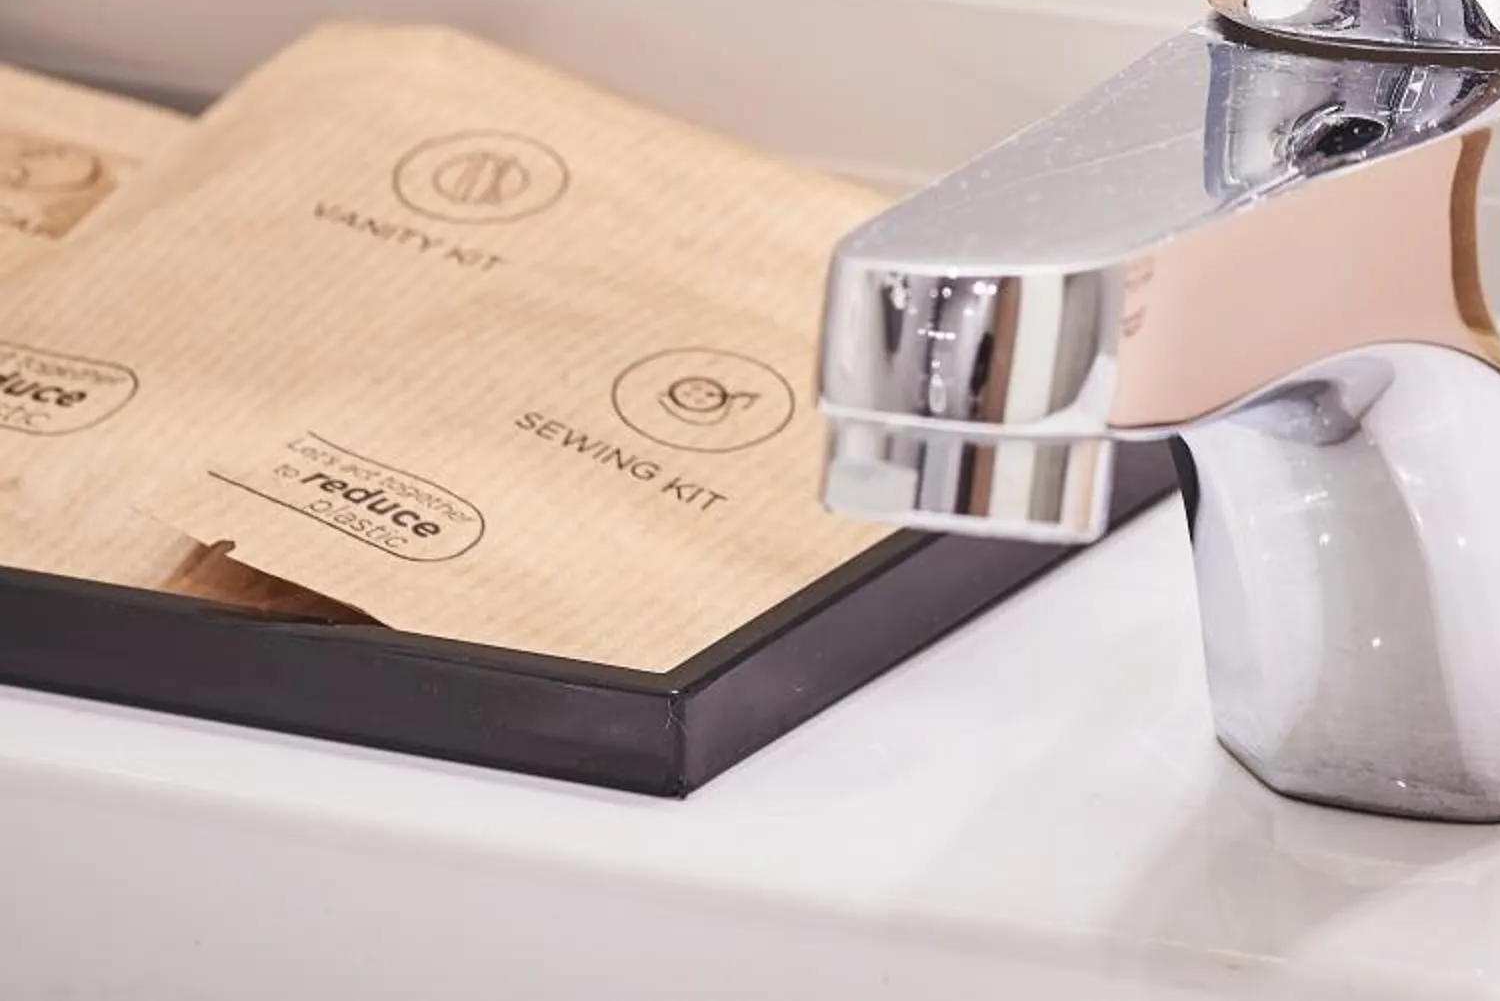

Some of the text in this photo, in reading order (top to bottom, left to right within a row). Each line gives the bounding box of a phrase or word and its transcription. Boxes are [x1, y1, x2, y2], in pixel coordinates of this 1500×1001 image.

[514, 410, 729, 511] SEWING KIT
[300, 471, 442, 539] reduce
[301, 498, 409, 549] plastic
